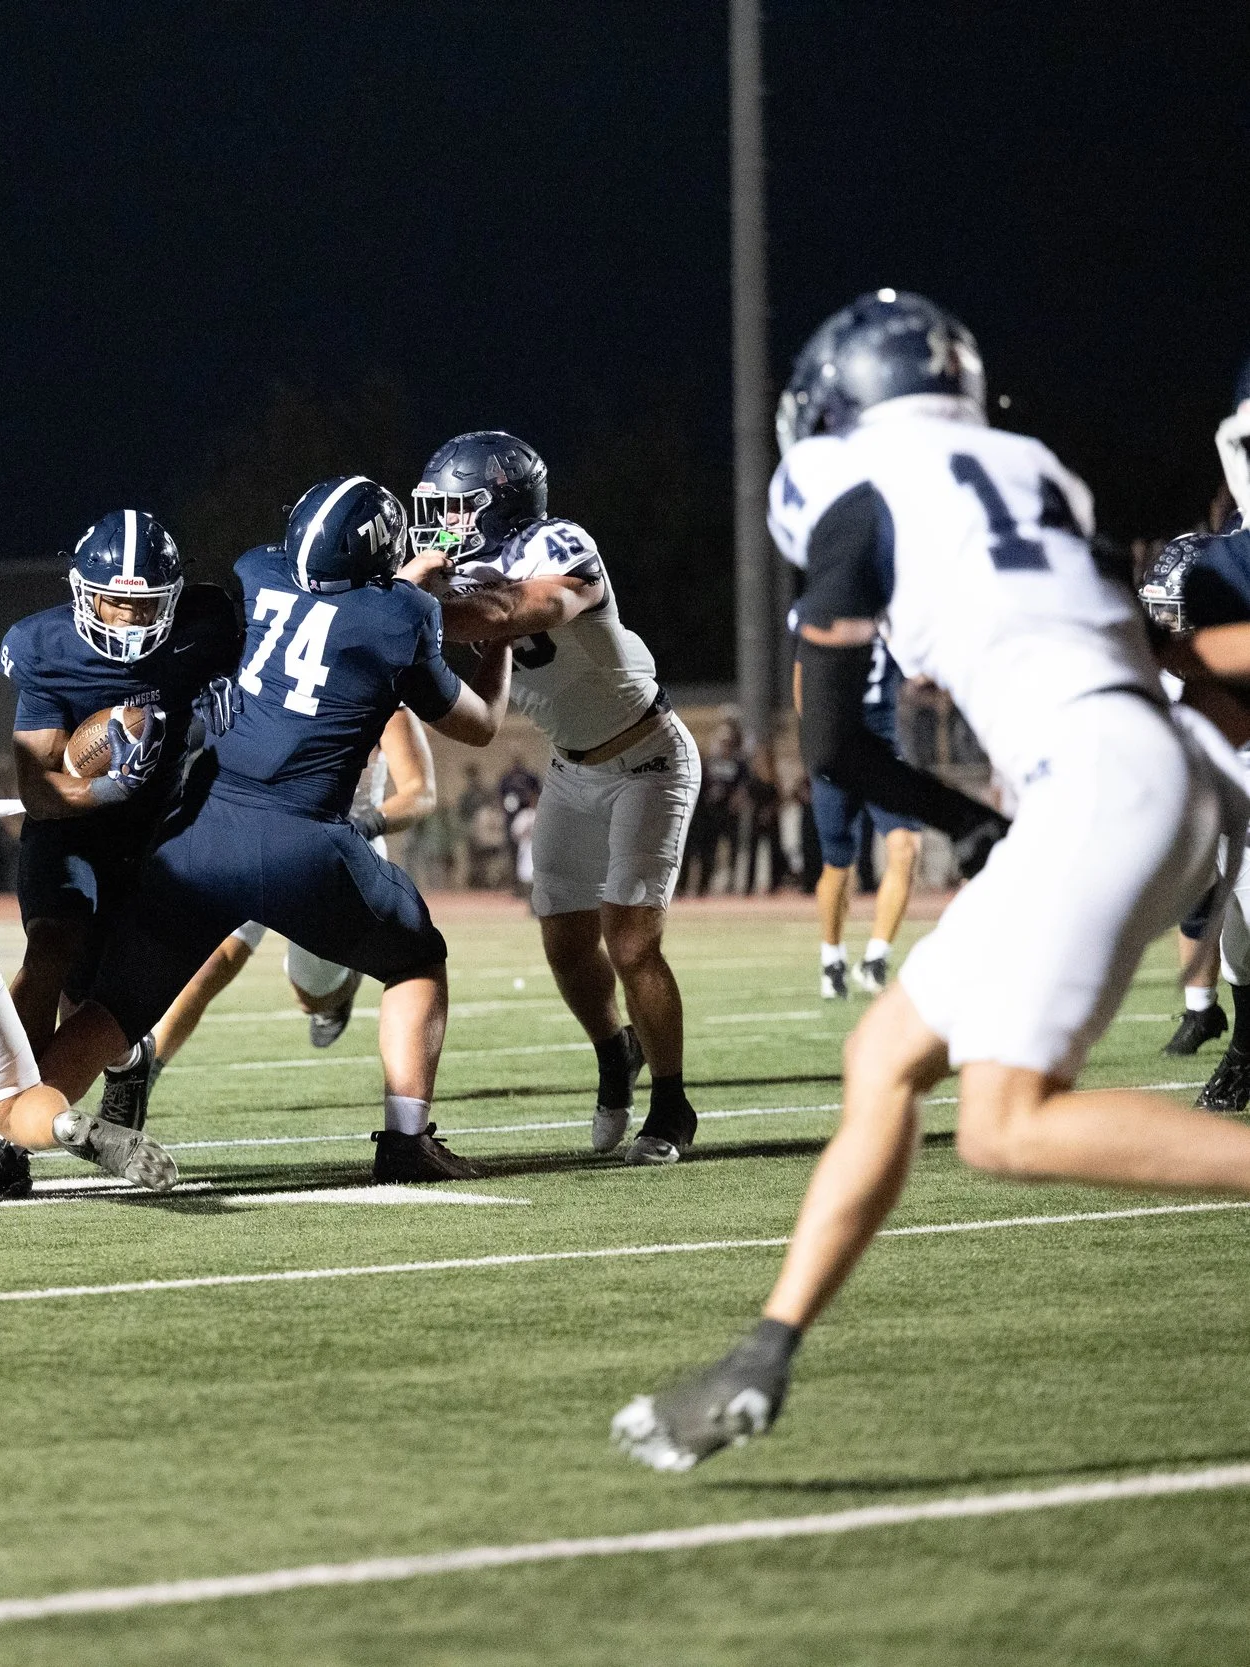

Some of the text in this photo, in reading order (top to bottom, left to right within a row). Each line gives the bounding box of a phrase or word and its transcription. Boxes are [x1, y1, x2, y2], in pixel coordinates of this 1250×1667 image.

[357, 513, 391, 556] 74
[544, 527, 585, 565] 45
[115, 578, 145, 587] Riddell
[238, 587, 339, 717] 74
